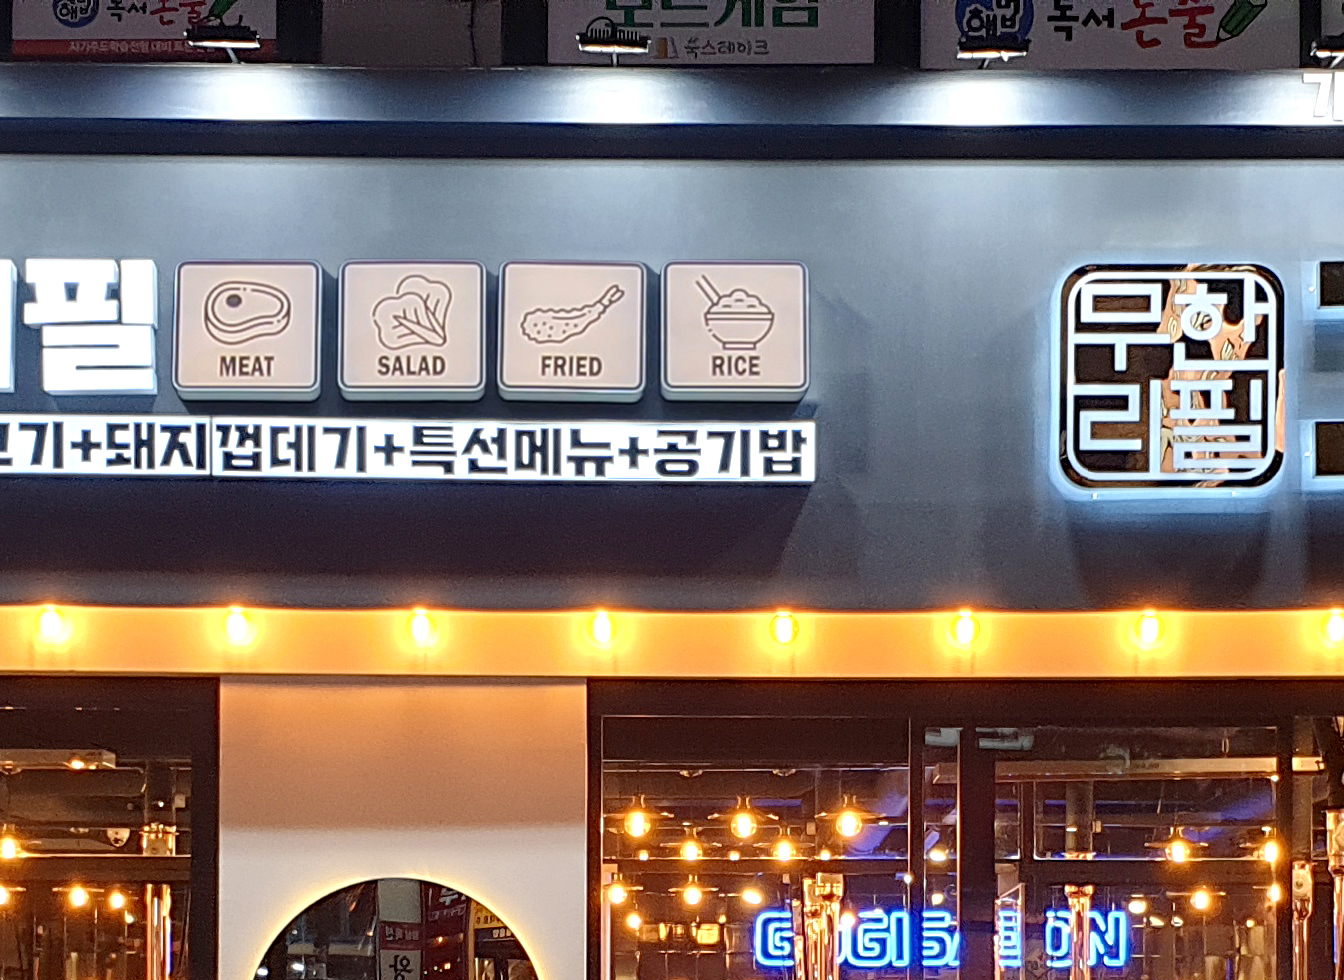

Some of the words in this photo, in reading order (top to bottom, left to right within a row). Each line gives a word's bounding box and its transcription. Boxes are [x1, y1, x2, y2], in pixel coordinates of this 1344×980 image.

[219, 355, 275, 378] MEAT
[376, 355, 446, 378] SALAD
[540, 355, 602, 378] FRIED
[711, 355, 761, 378] RICE
